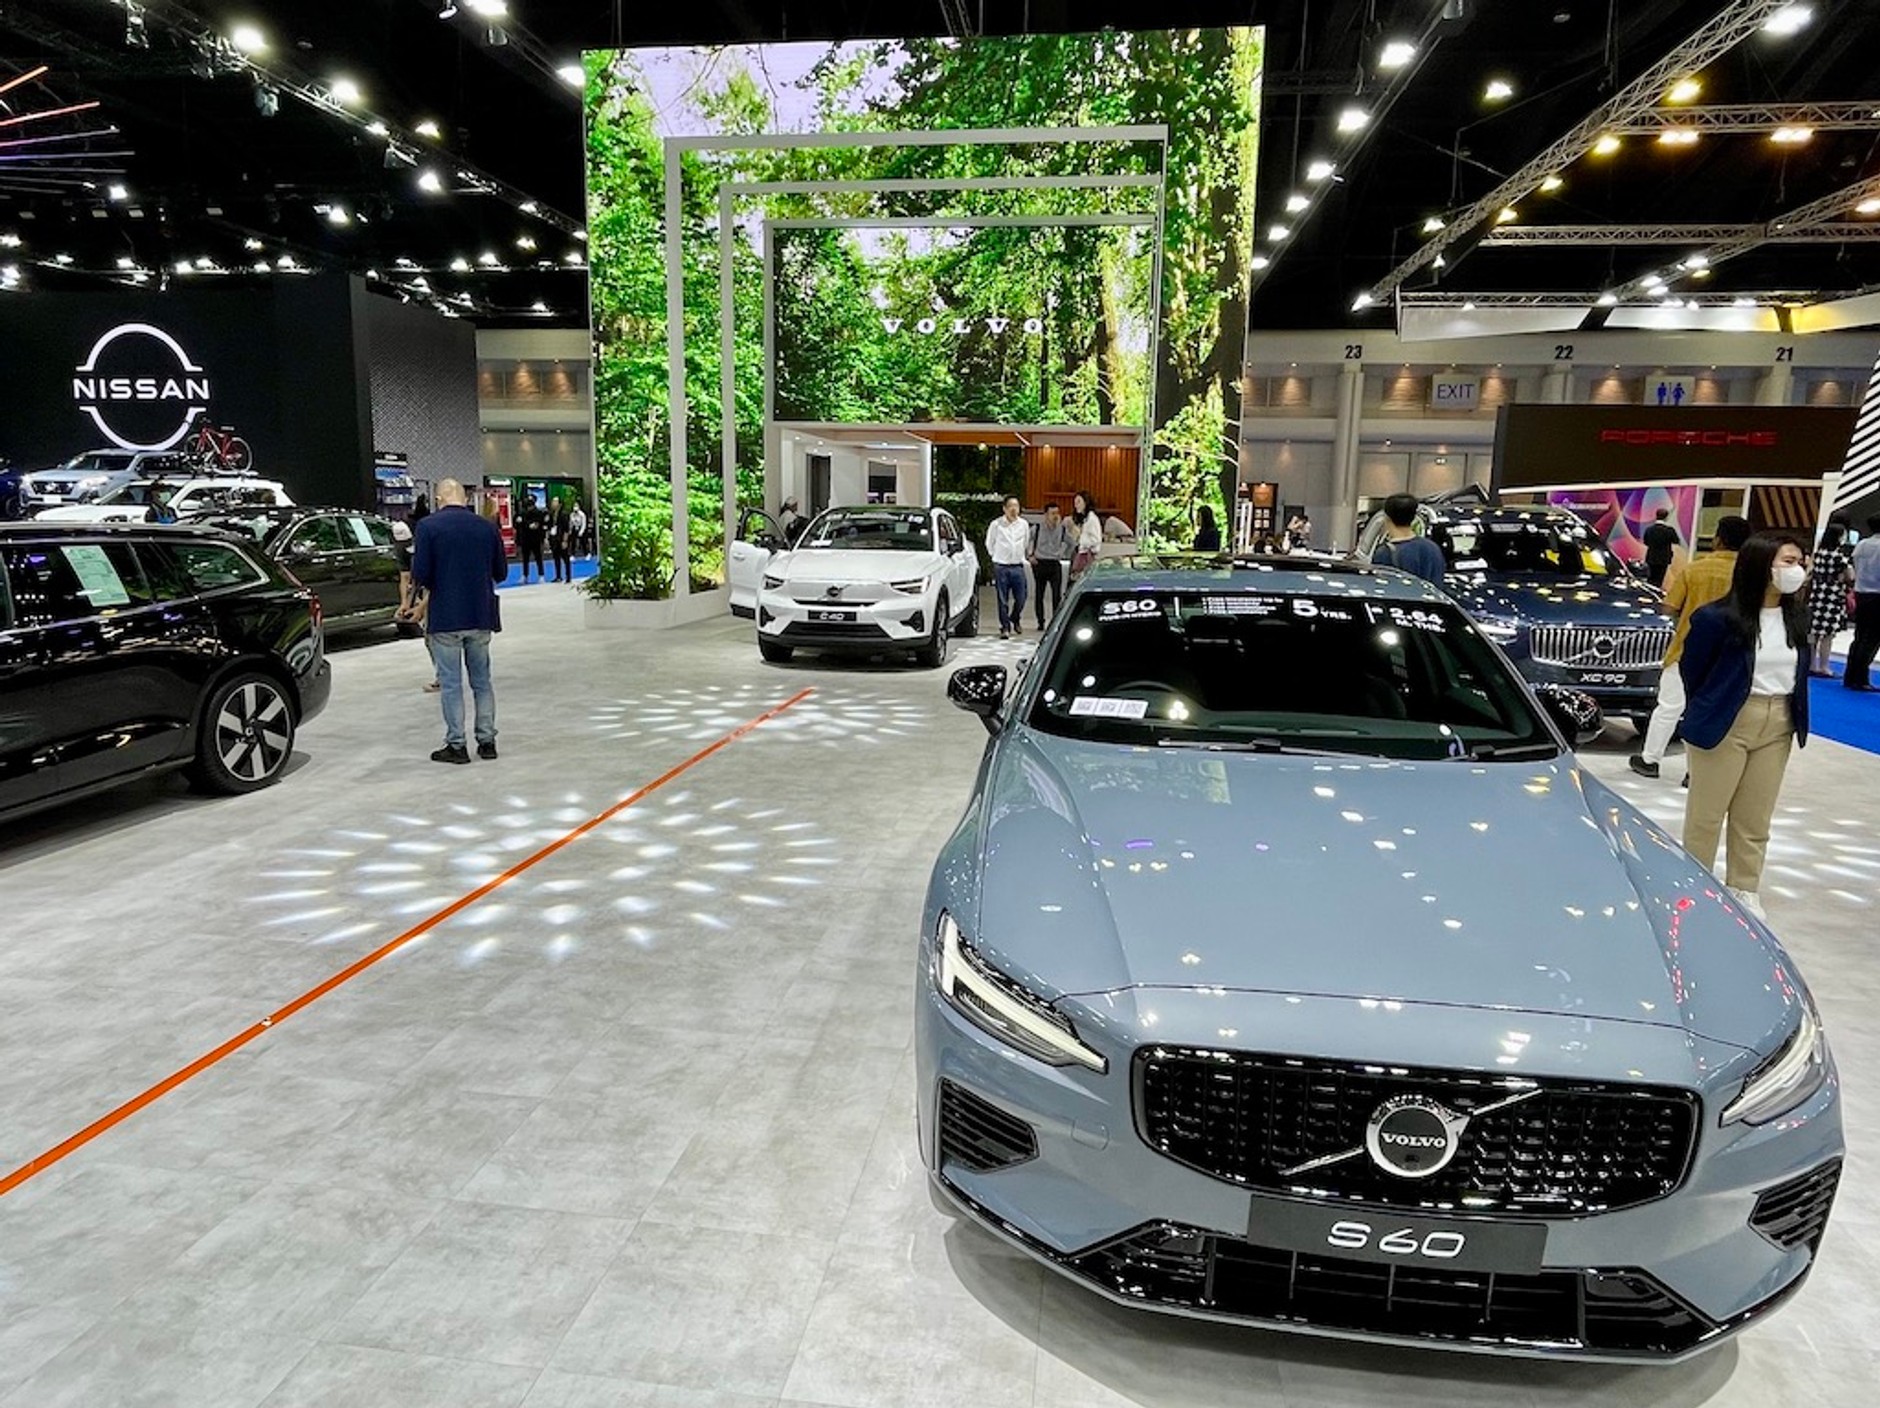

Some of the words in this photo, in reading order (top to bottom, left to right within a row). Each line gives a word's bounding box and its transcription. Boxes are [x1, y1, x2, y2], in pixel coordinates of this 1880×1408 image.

[879, 317, 1044, 335] VOLVO
[1344, 345, 1363, 359] 23
[1554, 345, 1574, 360] 22
[1775, 347, 1794, 362] 21
[72, 378, 210, 400] NISSAN
[1437, 383, 1475, 400] EXIT
[1601, 429, 1778, 445] PORSCHE
[1103, 598, 1158, 615] S60
[1292, 599, 1319, 618] 5
[1381, 1131, 1447, 1149] VOLVO
